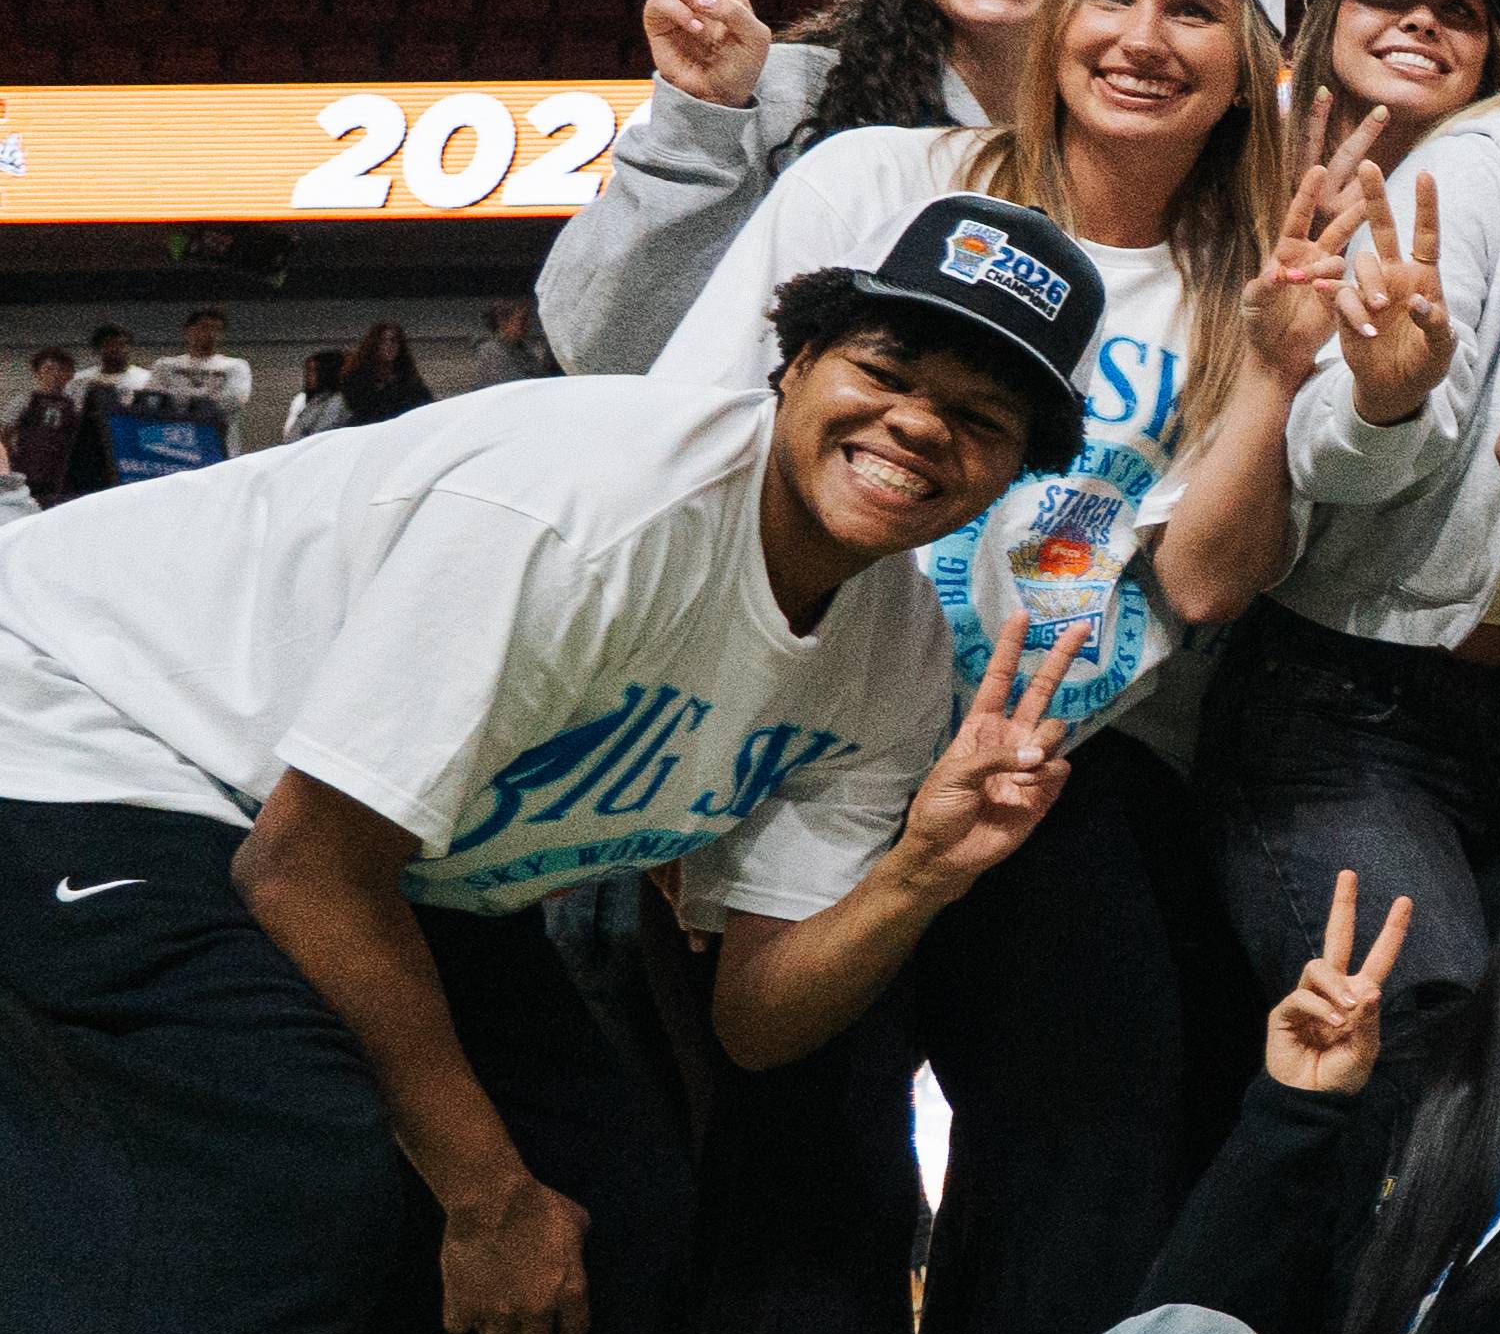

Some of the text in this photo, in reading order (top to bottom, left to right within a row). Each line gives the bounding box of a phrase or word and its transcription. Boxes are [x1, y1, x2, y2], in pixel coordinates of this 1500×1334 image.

[291, 92, 653, 209] 202
[984, 267, 1058, 317] CHAMPIONS
[991, 245, 1068, 307] 2026
[935, 555, 969, 609] BIG
